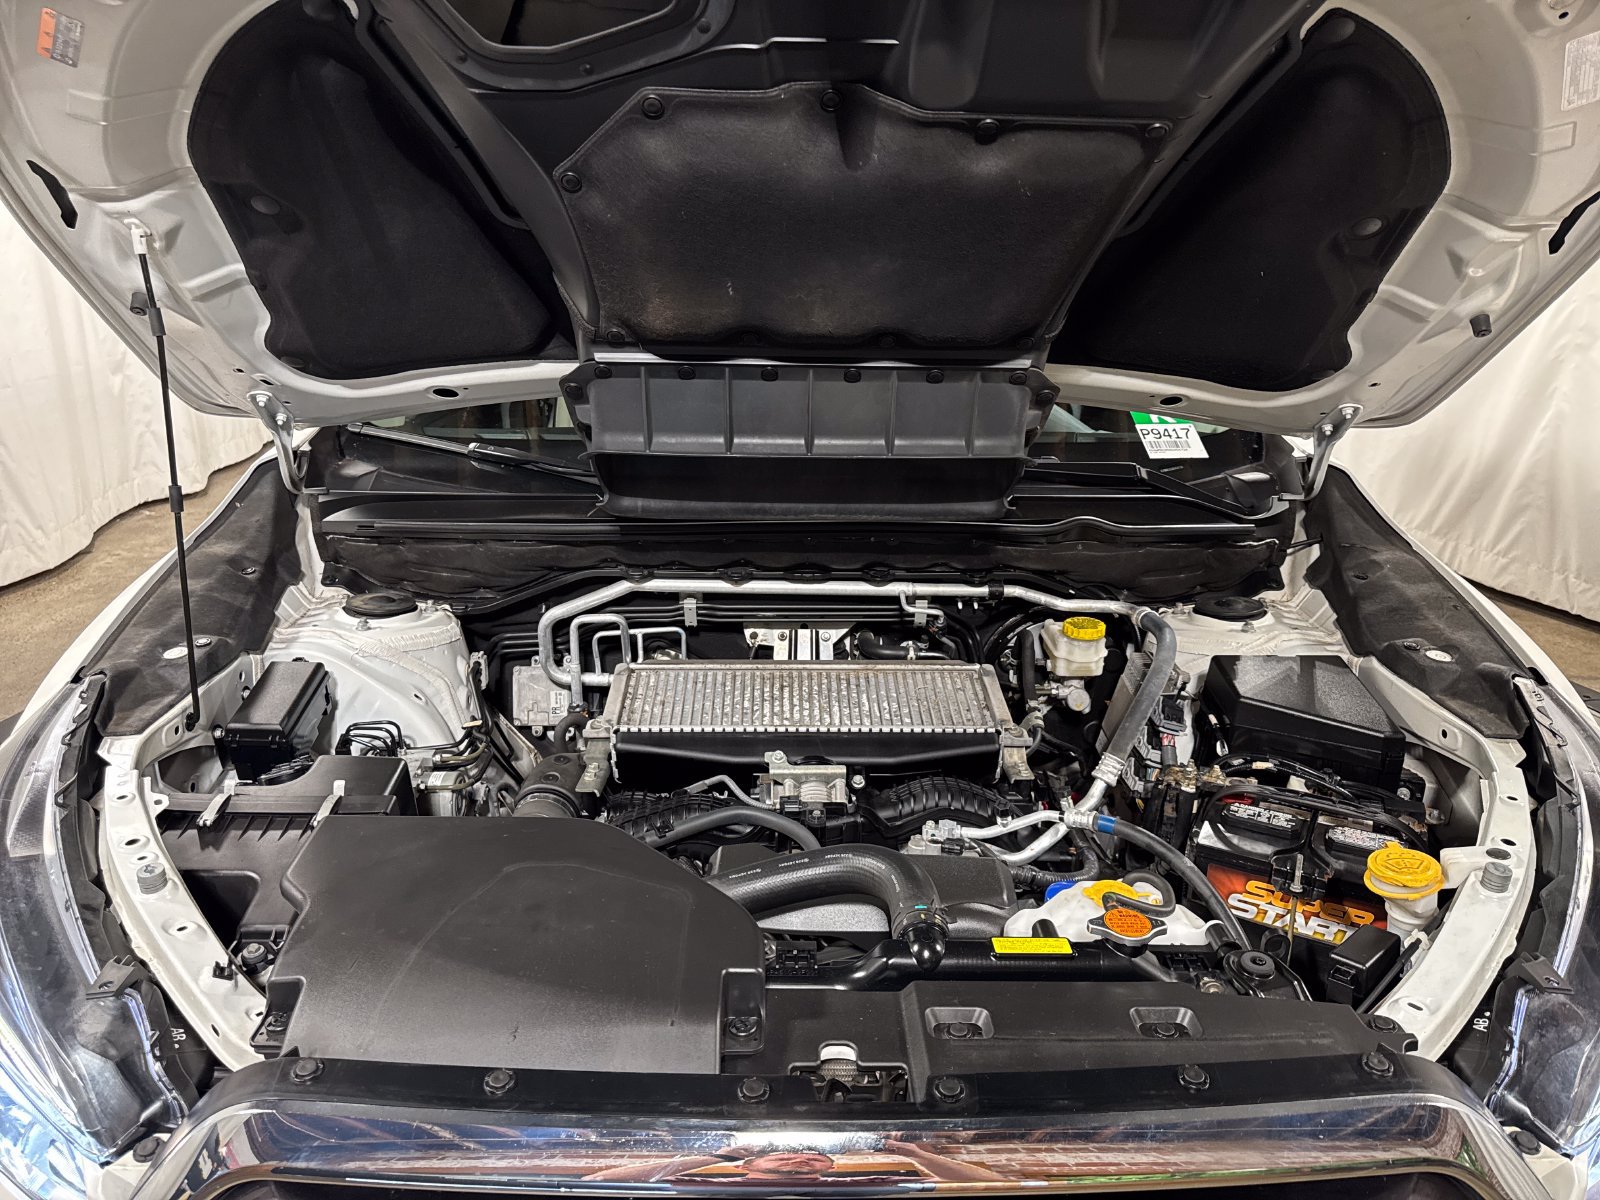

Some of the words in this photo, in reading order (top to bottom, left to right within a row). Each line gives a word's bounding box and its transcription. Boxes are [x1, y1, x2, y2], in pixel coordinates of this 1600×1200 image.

[1140, 428, 1190, 439] P9417
[552, 706, 560, 714] PR
[1242, 880, 1375, 926] SUPER
[1227, 893, 1371, 945] START
